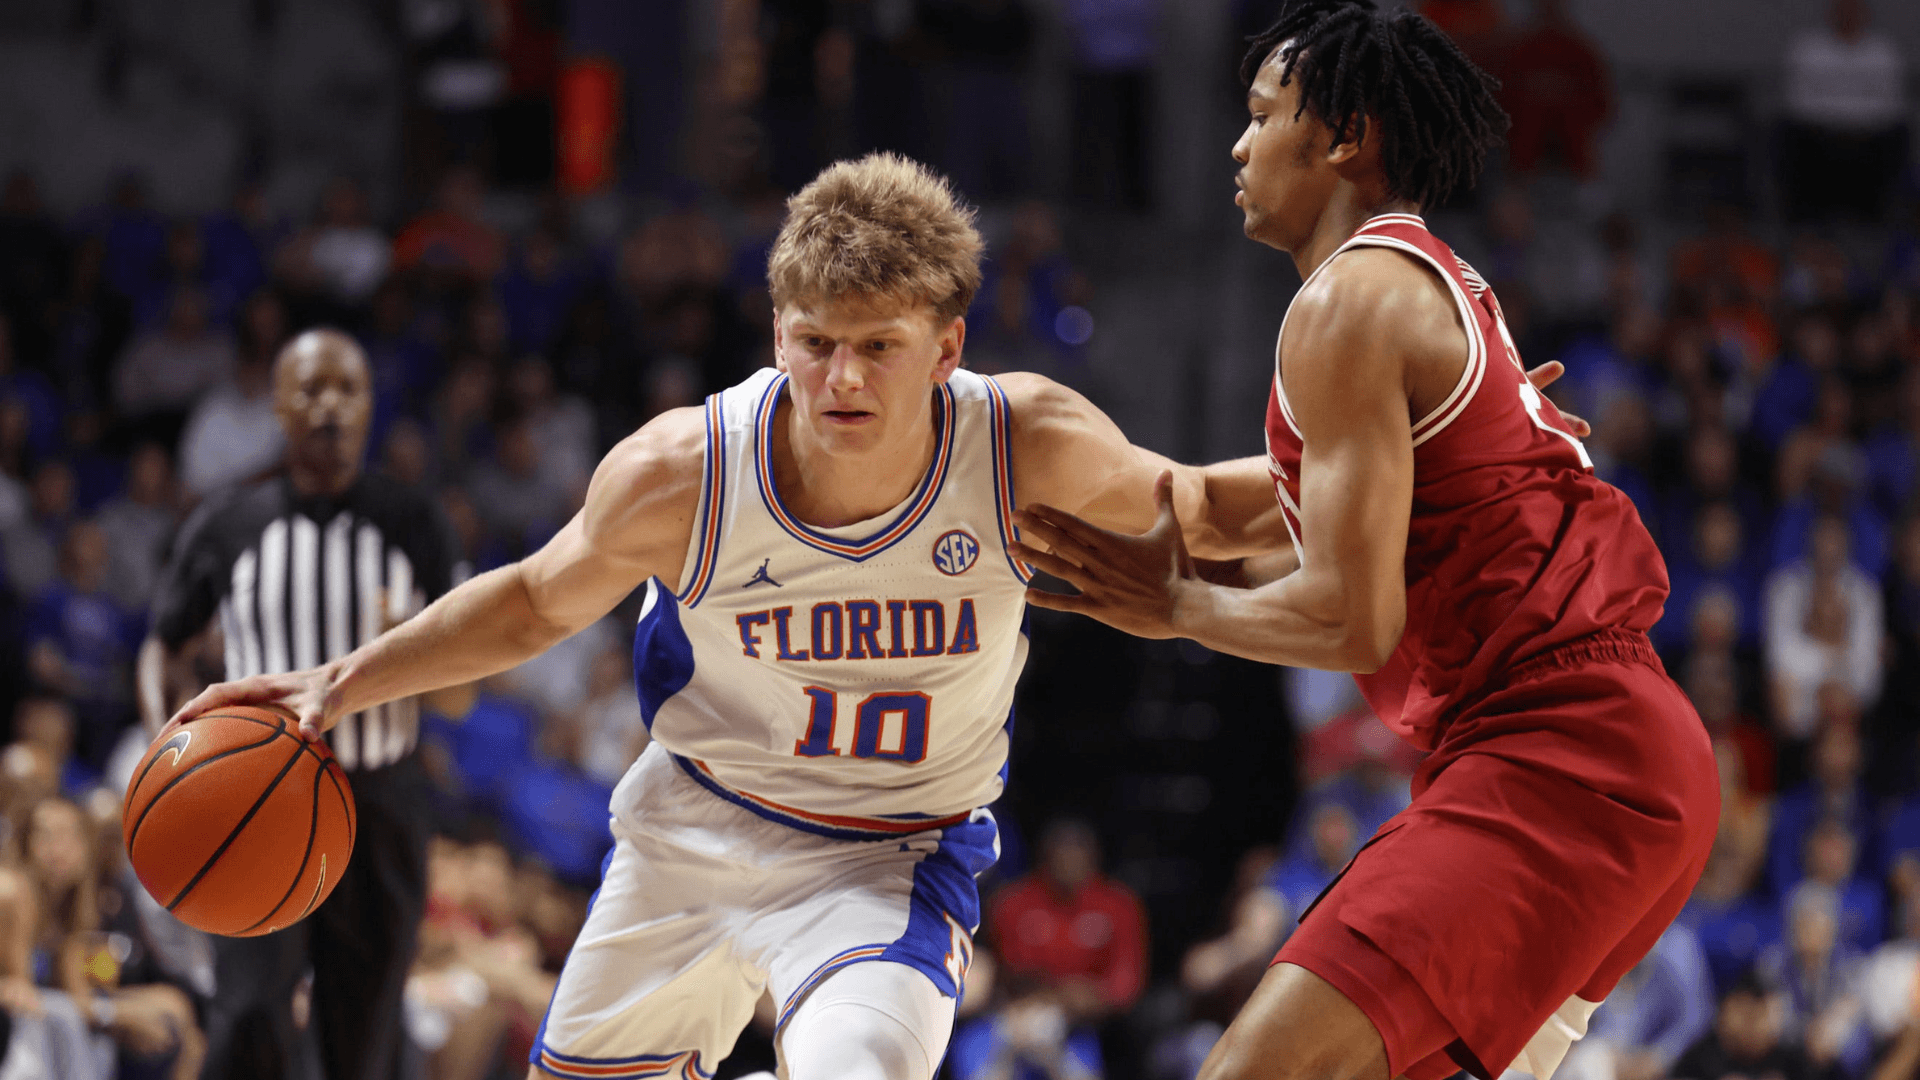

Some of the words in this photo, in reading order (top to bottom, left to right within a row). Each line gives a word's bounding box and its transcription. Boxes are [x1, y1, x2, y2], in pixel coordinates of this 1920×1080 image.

[935, 533, 976, 574] SEC
[736, 598, 980, 661] FLORIDA
[794, 685, 933, 764] 10
